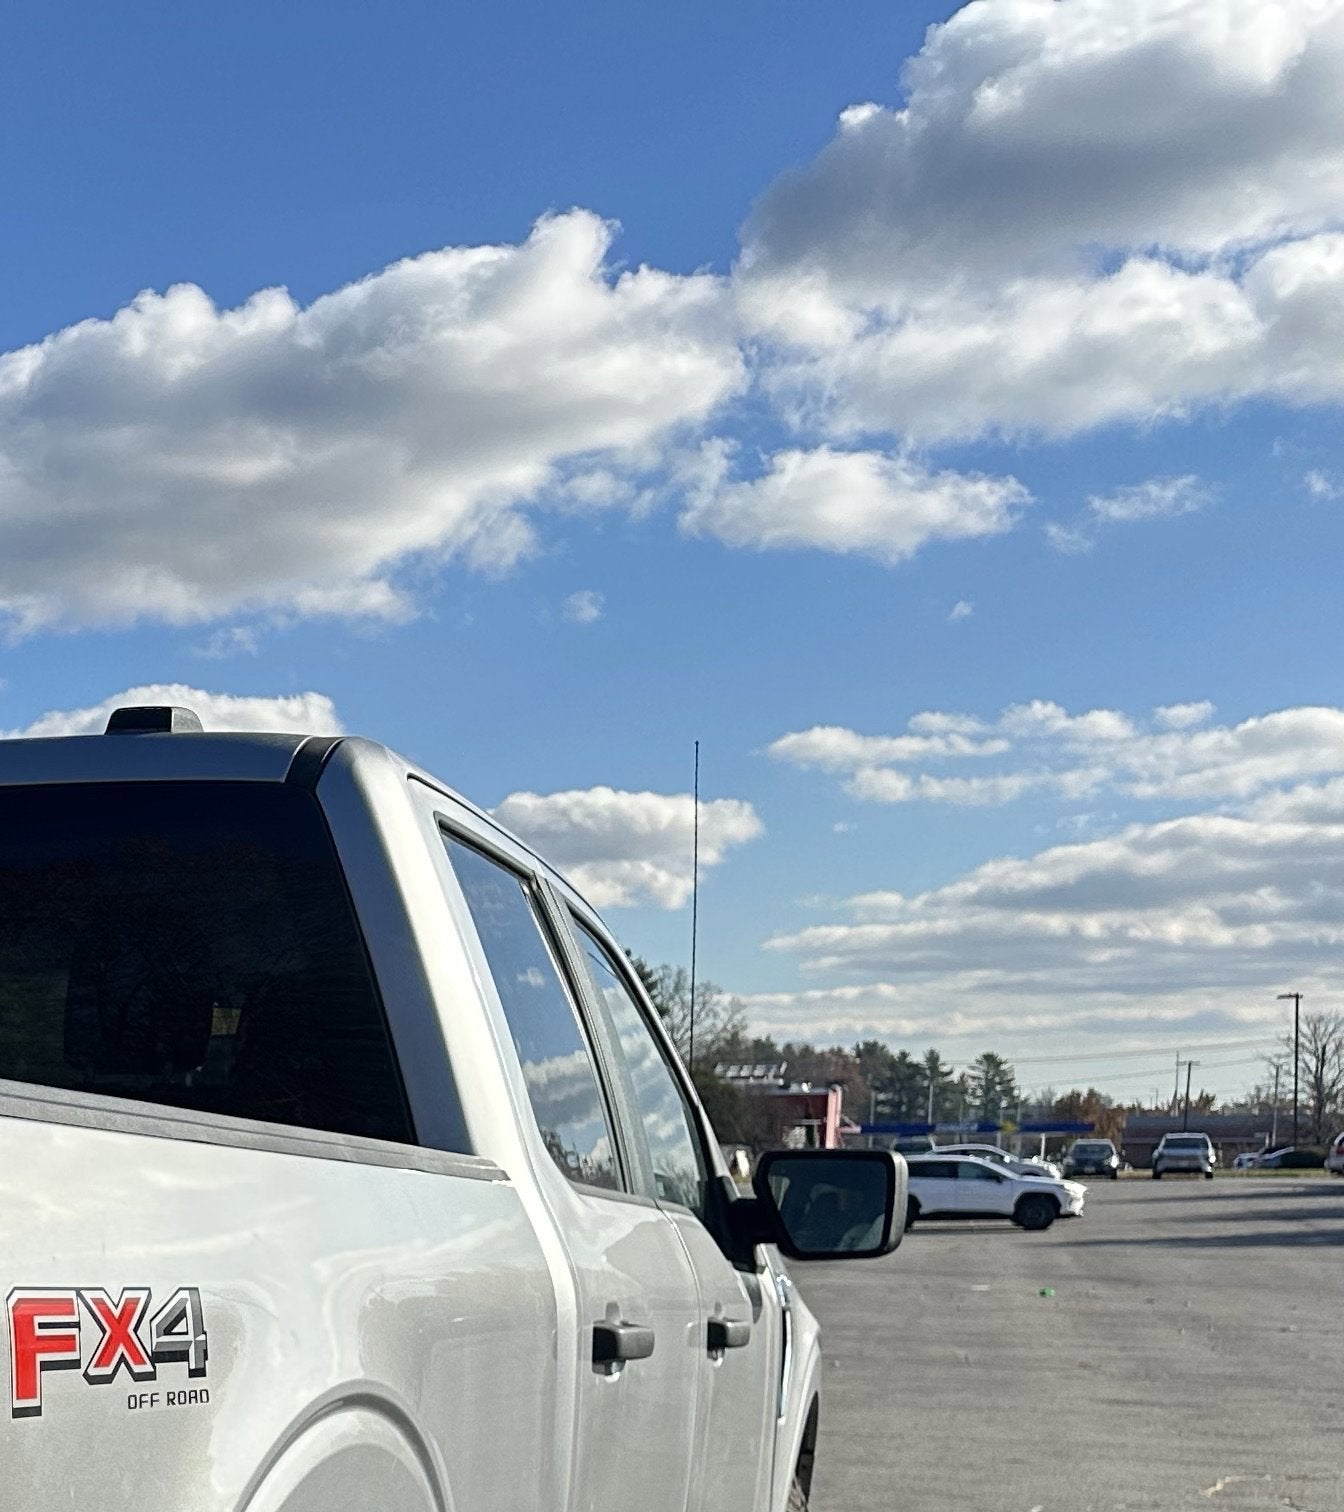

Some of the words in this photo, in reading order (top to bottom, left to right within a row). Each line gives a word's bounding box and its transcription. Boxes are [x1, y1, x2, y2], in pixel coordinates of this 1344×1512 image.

[6, 1286, 209, 1419] FX4
[127, 1393, 160, 1410] OFF
[166, 1388, 210, 1406] ROAD
